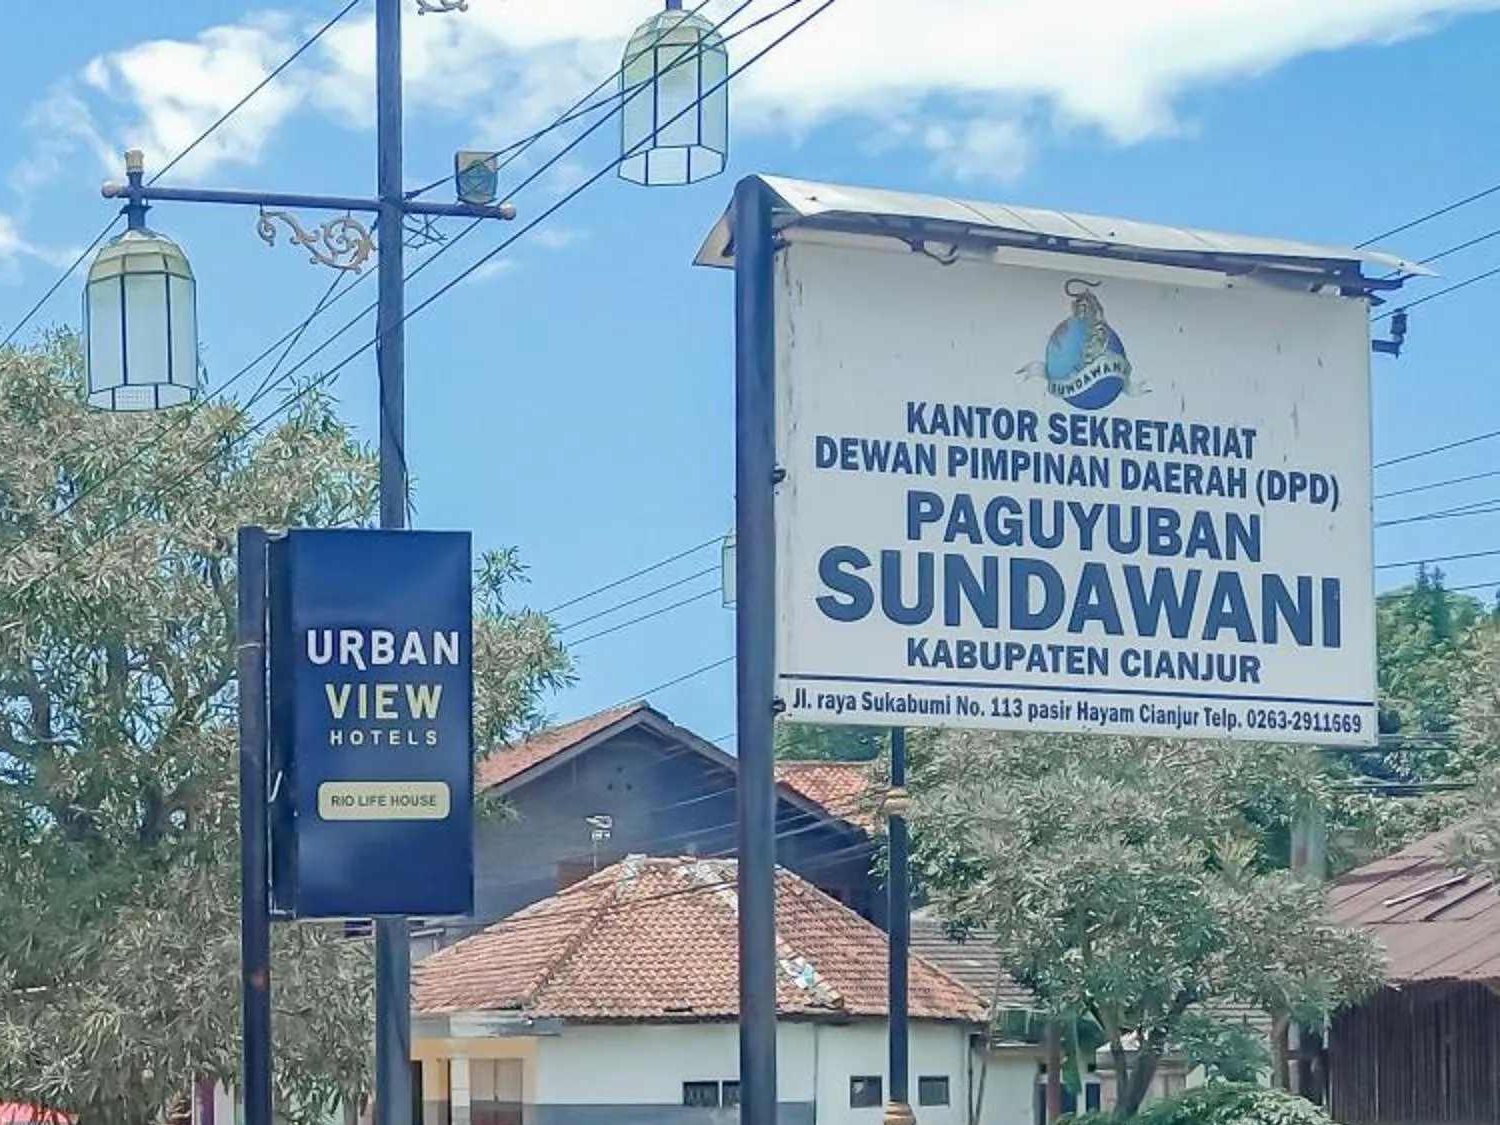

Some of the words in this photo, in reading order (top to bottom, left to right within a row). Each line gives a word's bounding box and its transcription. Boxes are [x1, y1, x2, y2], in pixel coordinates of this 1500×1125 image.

[907, 401, 1037, 443] KANTOR
[1048, 412, 1256, 459] SEKRETARIAT
[816, 436, 937, 476] DEWAN
[947, 446, 1109, 488] PIMPINAN
[1121, 459, 1246, 499] DAERAH
[1256, 470, 1339, 511] (DPD)
[906, 491, 1260, 562] PAGUYUBAN
[815, 546, 1341, 648] SUNDAWANI
[307, 629, 459, 672] URBAN
[907, 638, 1109, 676] KABUPATEN
[1121, 649, 1260, 683] CIANJUR
[325, 683, 442, 719] VIEW
[793, 688, 811, 709] Jl.
[817, 693, 856, 714] raya
[861, 691, 951, 715] Sukabumi
[956, 696, 985, 716] No.
[991, 697, 1023, 718] 113
[1028, 699, 1072, 722] pasir
[1077, 701, 1134, 726] Hayam
[1139, 704, 1199, 729] Cianjur
[1204, 707, 1241, 731] Telp.
[330, 729, 437, 746] HOTELS
[331, 795, 355, 807] RIO
[358, 795, 387, 807] LIFE
[391, 795, 437, 807] HOUSE
